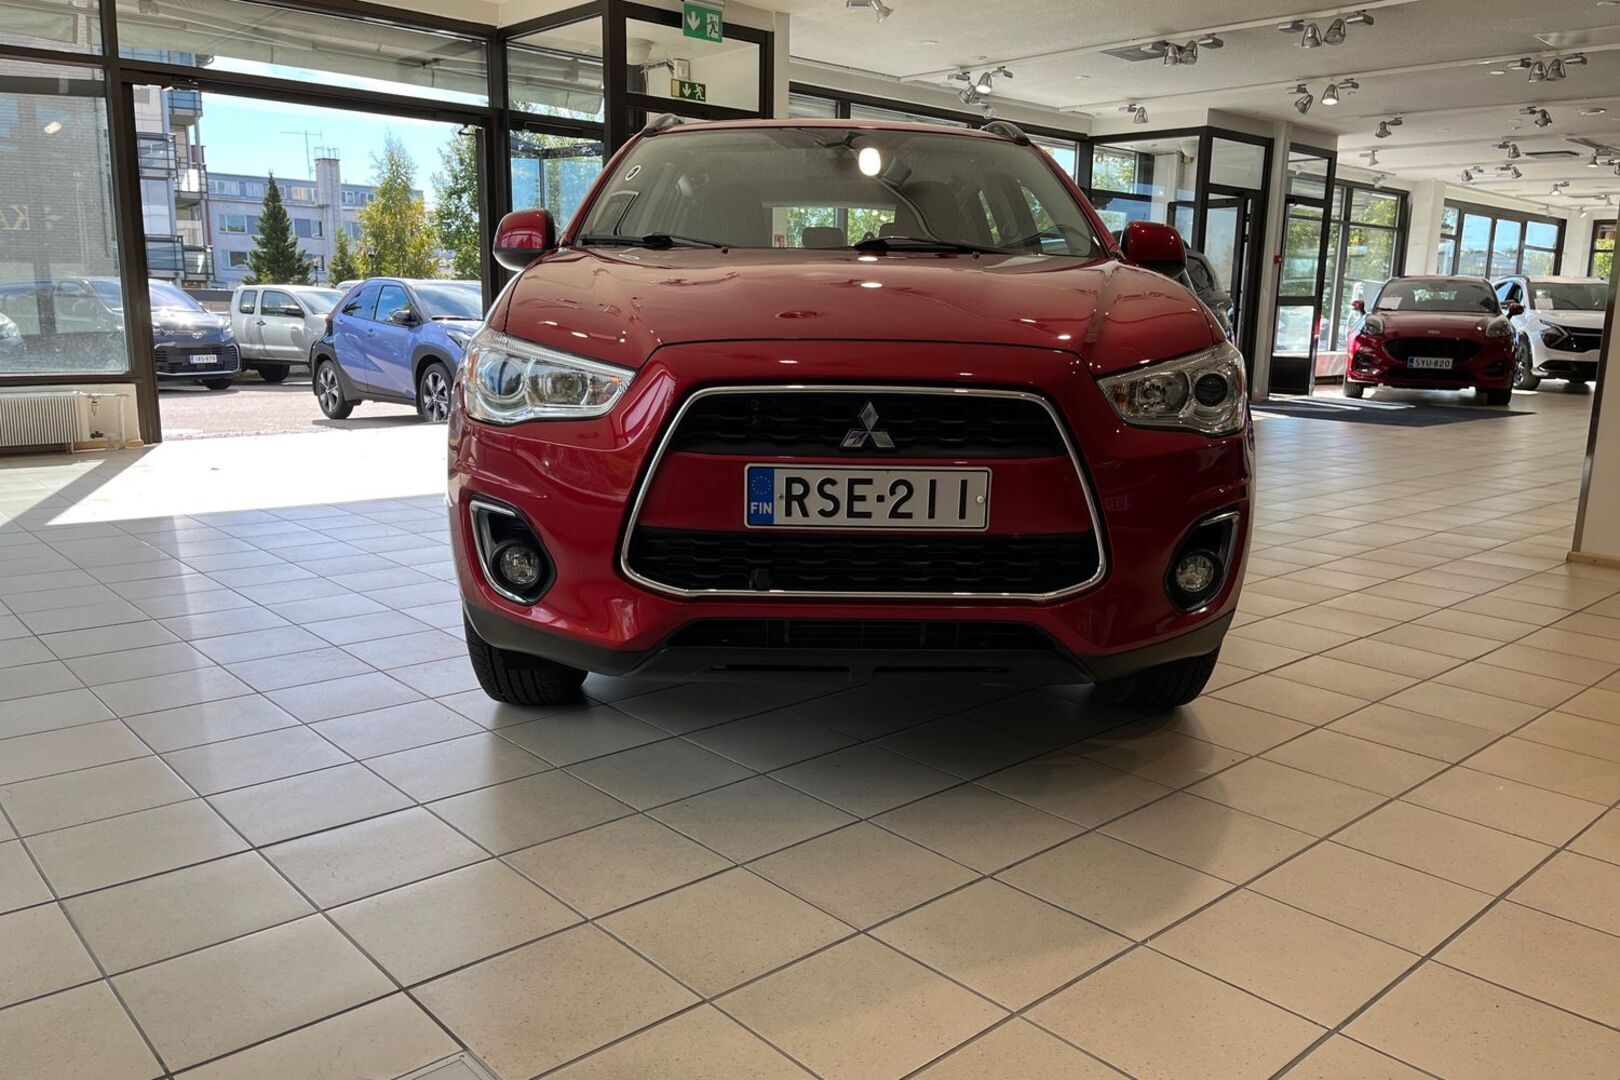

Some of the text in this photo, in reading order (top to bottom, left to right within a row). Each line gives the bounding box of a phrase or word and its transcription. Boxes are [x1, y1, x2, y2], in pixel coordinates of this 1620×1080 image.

[1415, 358, 1450, 368] SYU-820
[784, 476, 968, 519] RSE-211
[750, 502, 772, 514] FIN
